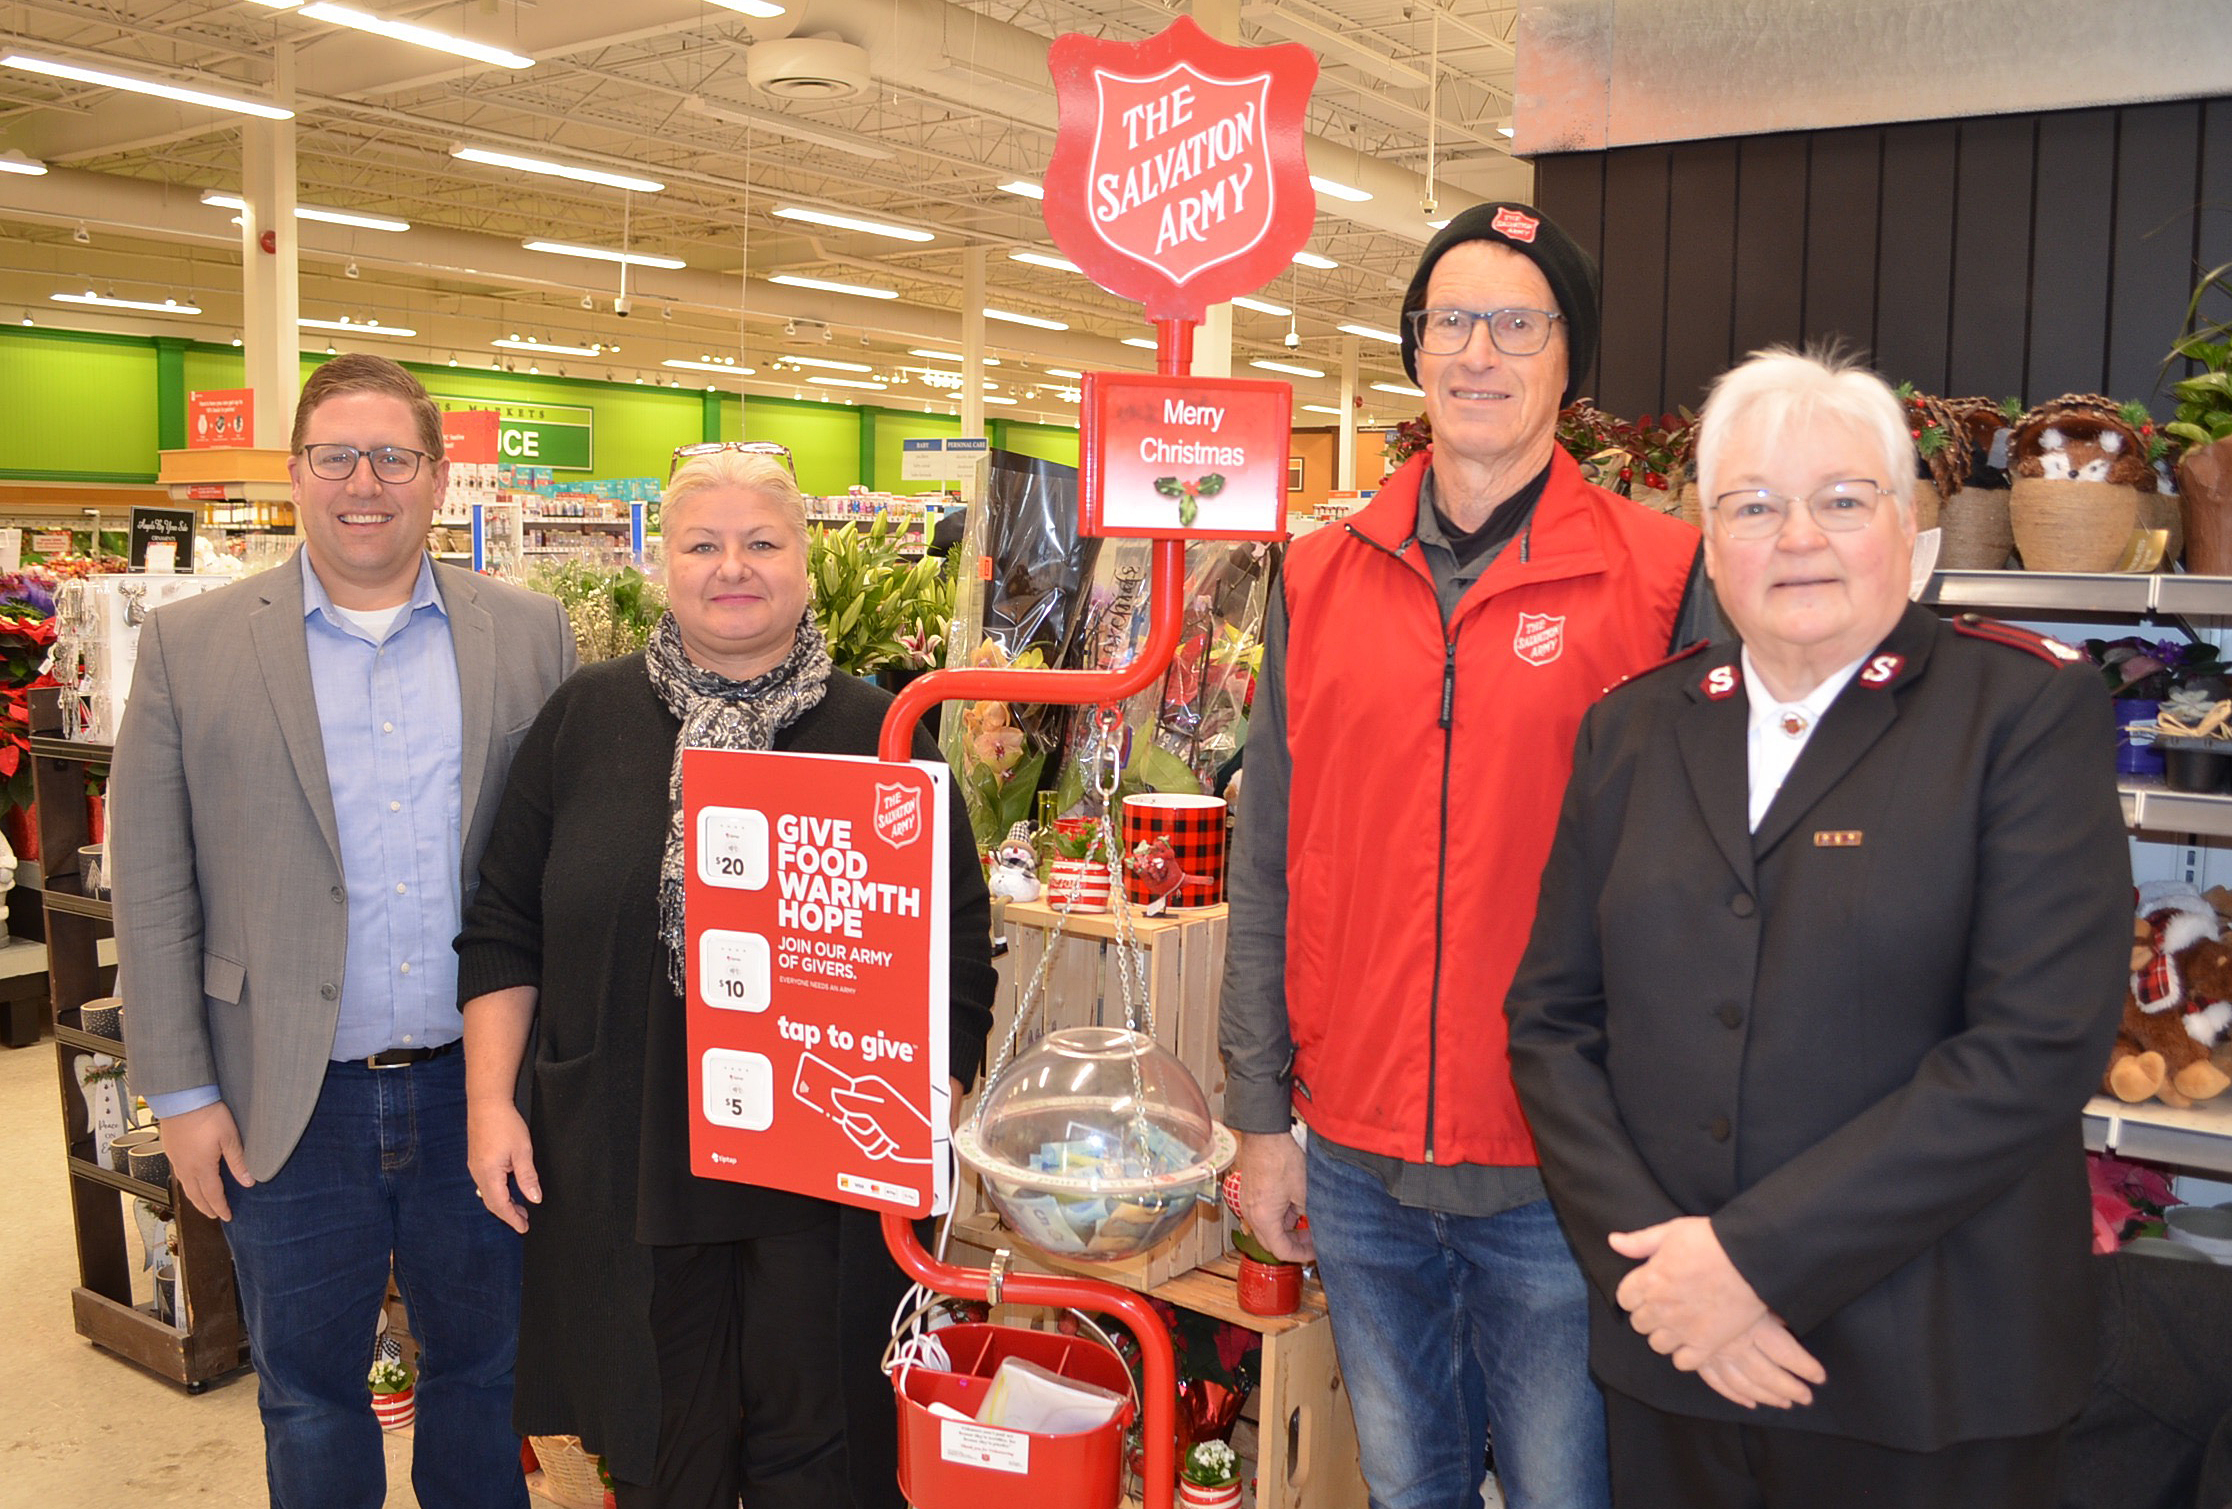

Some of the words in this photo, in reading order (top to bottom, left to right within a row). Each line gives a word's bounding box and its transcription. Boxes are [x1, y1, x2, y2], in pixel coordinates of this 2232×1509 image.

[1123, 85, 1195, 150] THE
[1097, 102, 1255, 222] SALVATION
[1155, 163, 1253, 255] ARMY
[1164, 399, 1225, 432] Merry
[947, 441, 972, 449] PERSONAL
[973, 441, 986, 449] CARE
[1140, 437, 1245, 466] Christmas
[1518, 625, 1559, 650] SALVATION
[1526, 619, 1546, 635] THE
[1530, 638, 1558, 658] ARMY
[1708, 665, 1734, 694] S
[1861, 655, 1898, 682] S
[878, 796, 915, 829] SALVATION
[884, 791, 902, 810] THE
[777, 814, 852, 850] GIVE
[891, 813, 915, 838] ARMY
[716, 856, 744, 876] $20
[777, 842, 868, 880] FOOD
[777, 870, 920, 918] WARMTH
[778, 898, 863, 939] HOPE
[778, 936, 811, 954] JOIN
[815, 942, 847, 960] OUR
[850, 947, 893, 967] ARMY
[778, 954, 799, 969] OF
[801, 957, 858, 980] GIVERS.
[719, 979, 745, 998] $10
[779, 975, 809, 987] EVERYONE
[810, 981, 829, 990] NEEDS
[839, 986, 856, 994] ARMY
[777, 1015, 821, 1050] tap
[827, 1024, 854, 1050] to
[725, 1098, 743, 1116] $5
